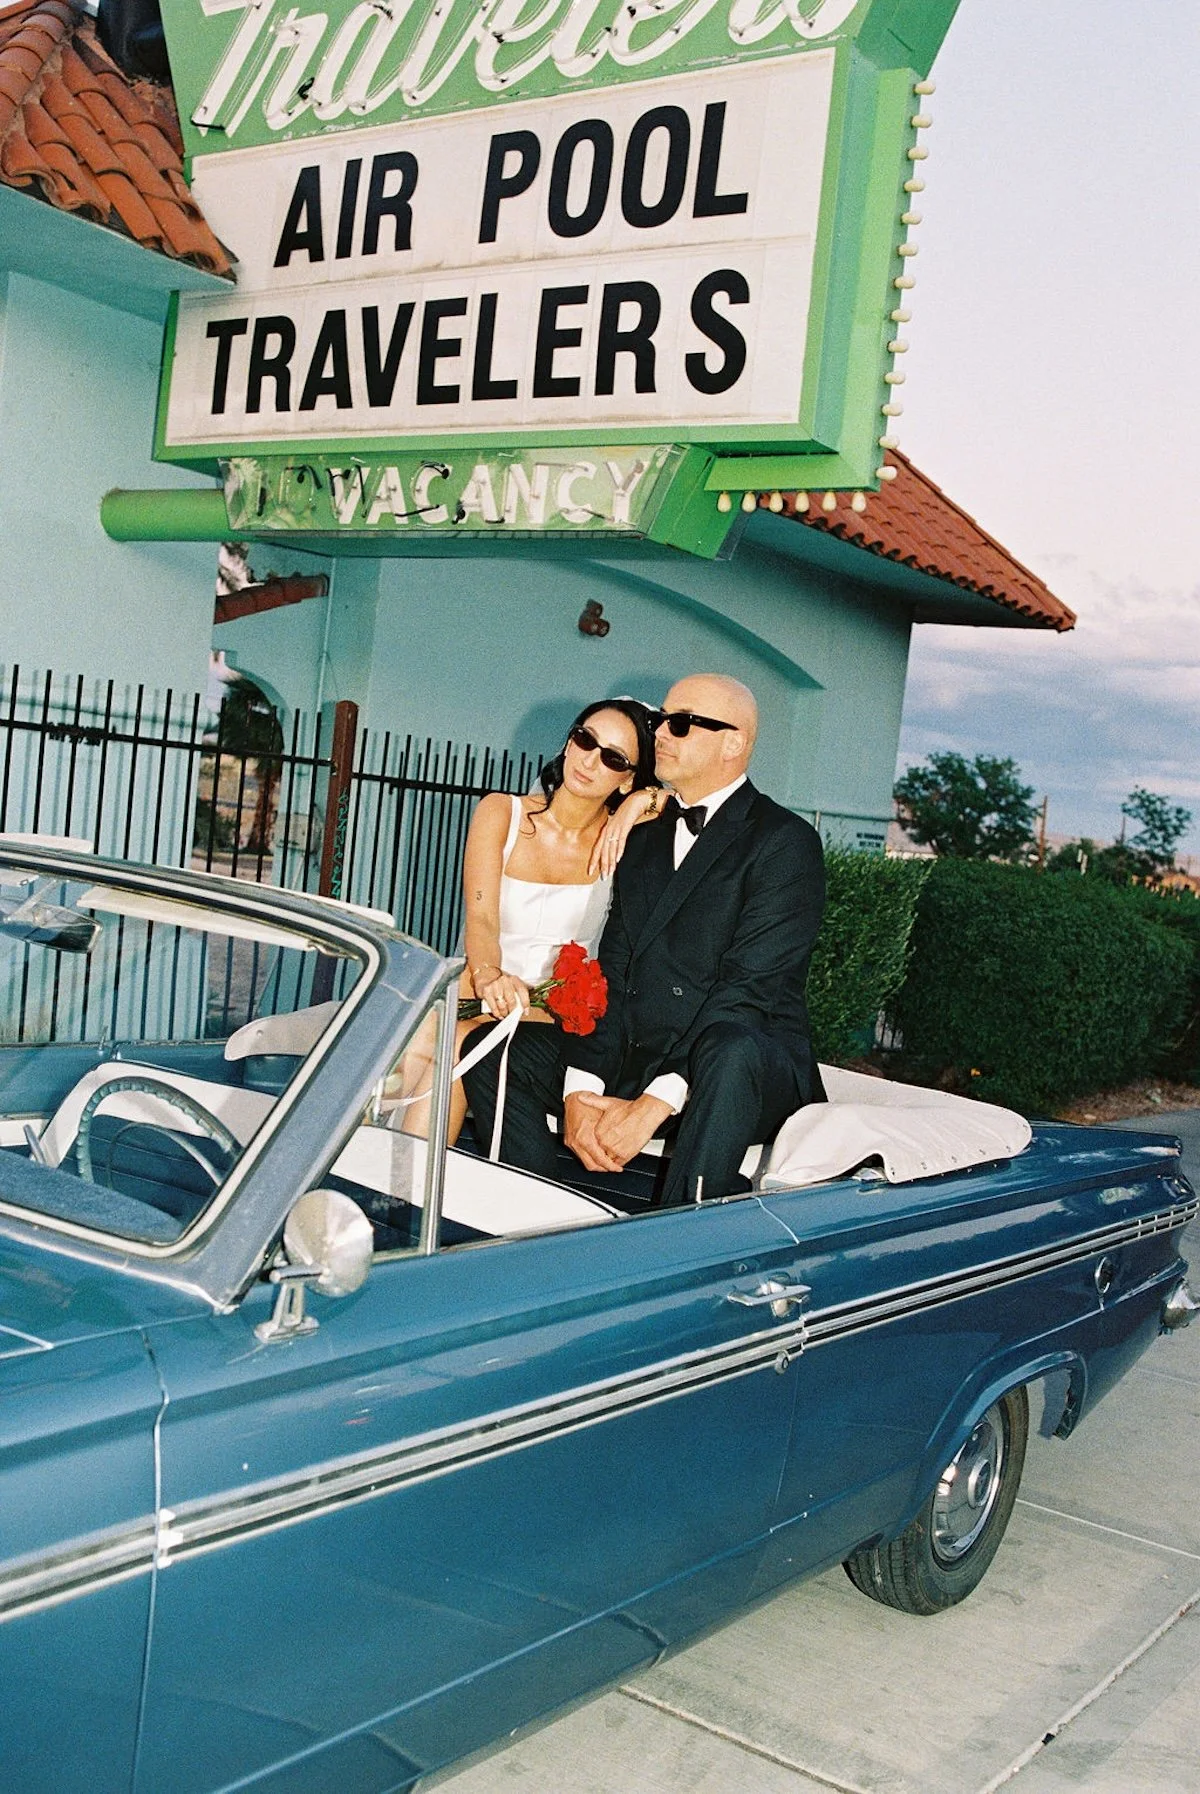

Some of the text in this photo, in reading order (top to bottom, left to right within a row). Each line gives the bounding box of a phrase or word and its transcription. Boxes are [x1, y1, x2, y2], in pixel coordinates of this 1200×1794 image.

[273, 101, 749, 268] AIR POOL
[205, 269, 750, 415] TRAVELERS
[331, 460, 651, 525] VACANCY
